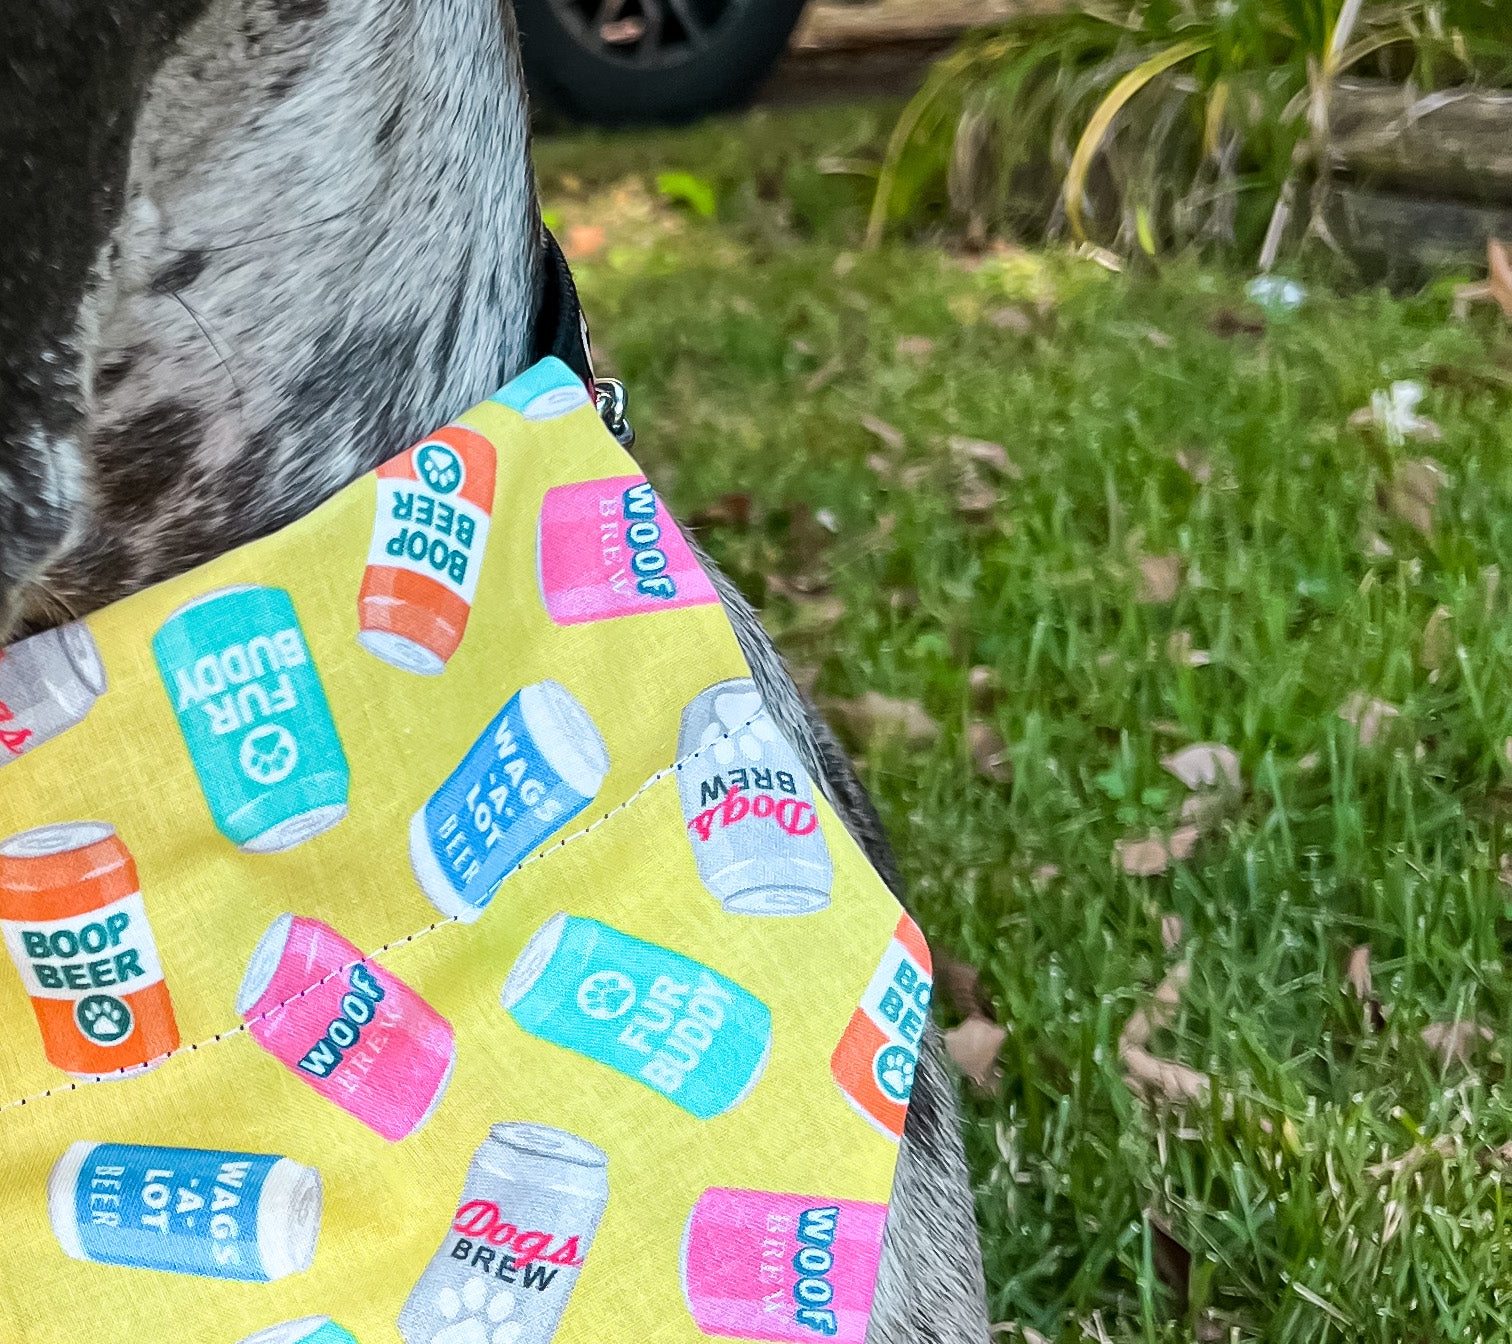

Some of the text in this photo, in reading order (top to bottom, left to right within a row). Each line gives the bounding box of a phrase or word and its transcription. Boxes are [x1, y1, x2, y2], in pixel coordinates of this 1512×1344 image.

[393, 491, 475, 550] BEER
[623, 482, 676, 599] WOOF
[386, 528, 468, 585] BOOP
[176, 628, 306, 713] BUDDY
[203, 673, 298, 735] FUR
[494, 715, 563, 822] WAGS
[700, 767, 797, 807] BREW
[466, 783, 503, 848] LOT
[688, 785, 819, 841] Dogs
[439, 814, 479, 884] BEER
[22, 911, 130, 958] BOOP
[32, 947, 145, 990] BEER
[297, 963, 385, 1078] WOOF
[618, 975, 691, 1056] FUR
[640, 971, 735, 1094] BUDDY
[90, 1165, 126, 1228] BEER
[141, 1169, 175, 1235] LOT
[209, 1161, 252, 1266] WAGS
[450, 1237, 559, 1292] BREW
[453, 1199, 585, 1269] Dogs
[792, 1206, 840, 1336] WOOF
